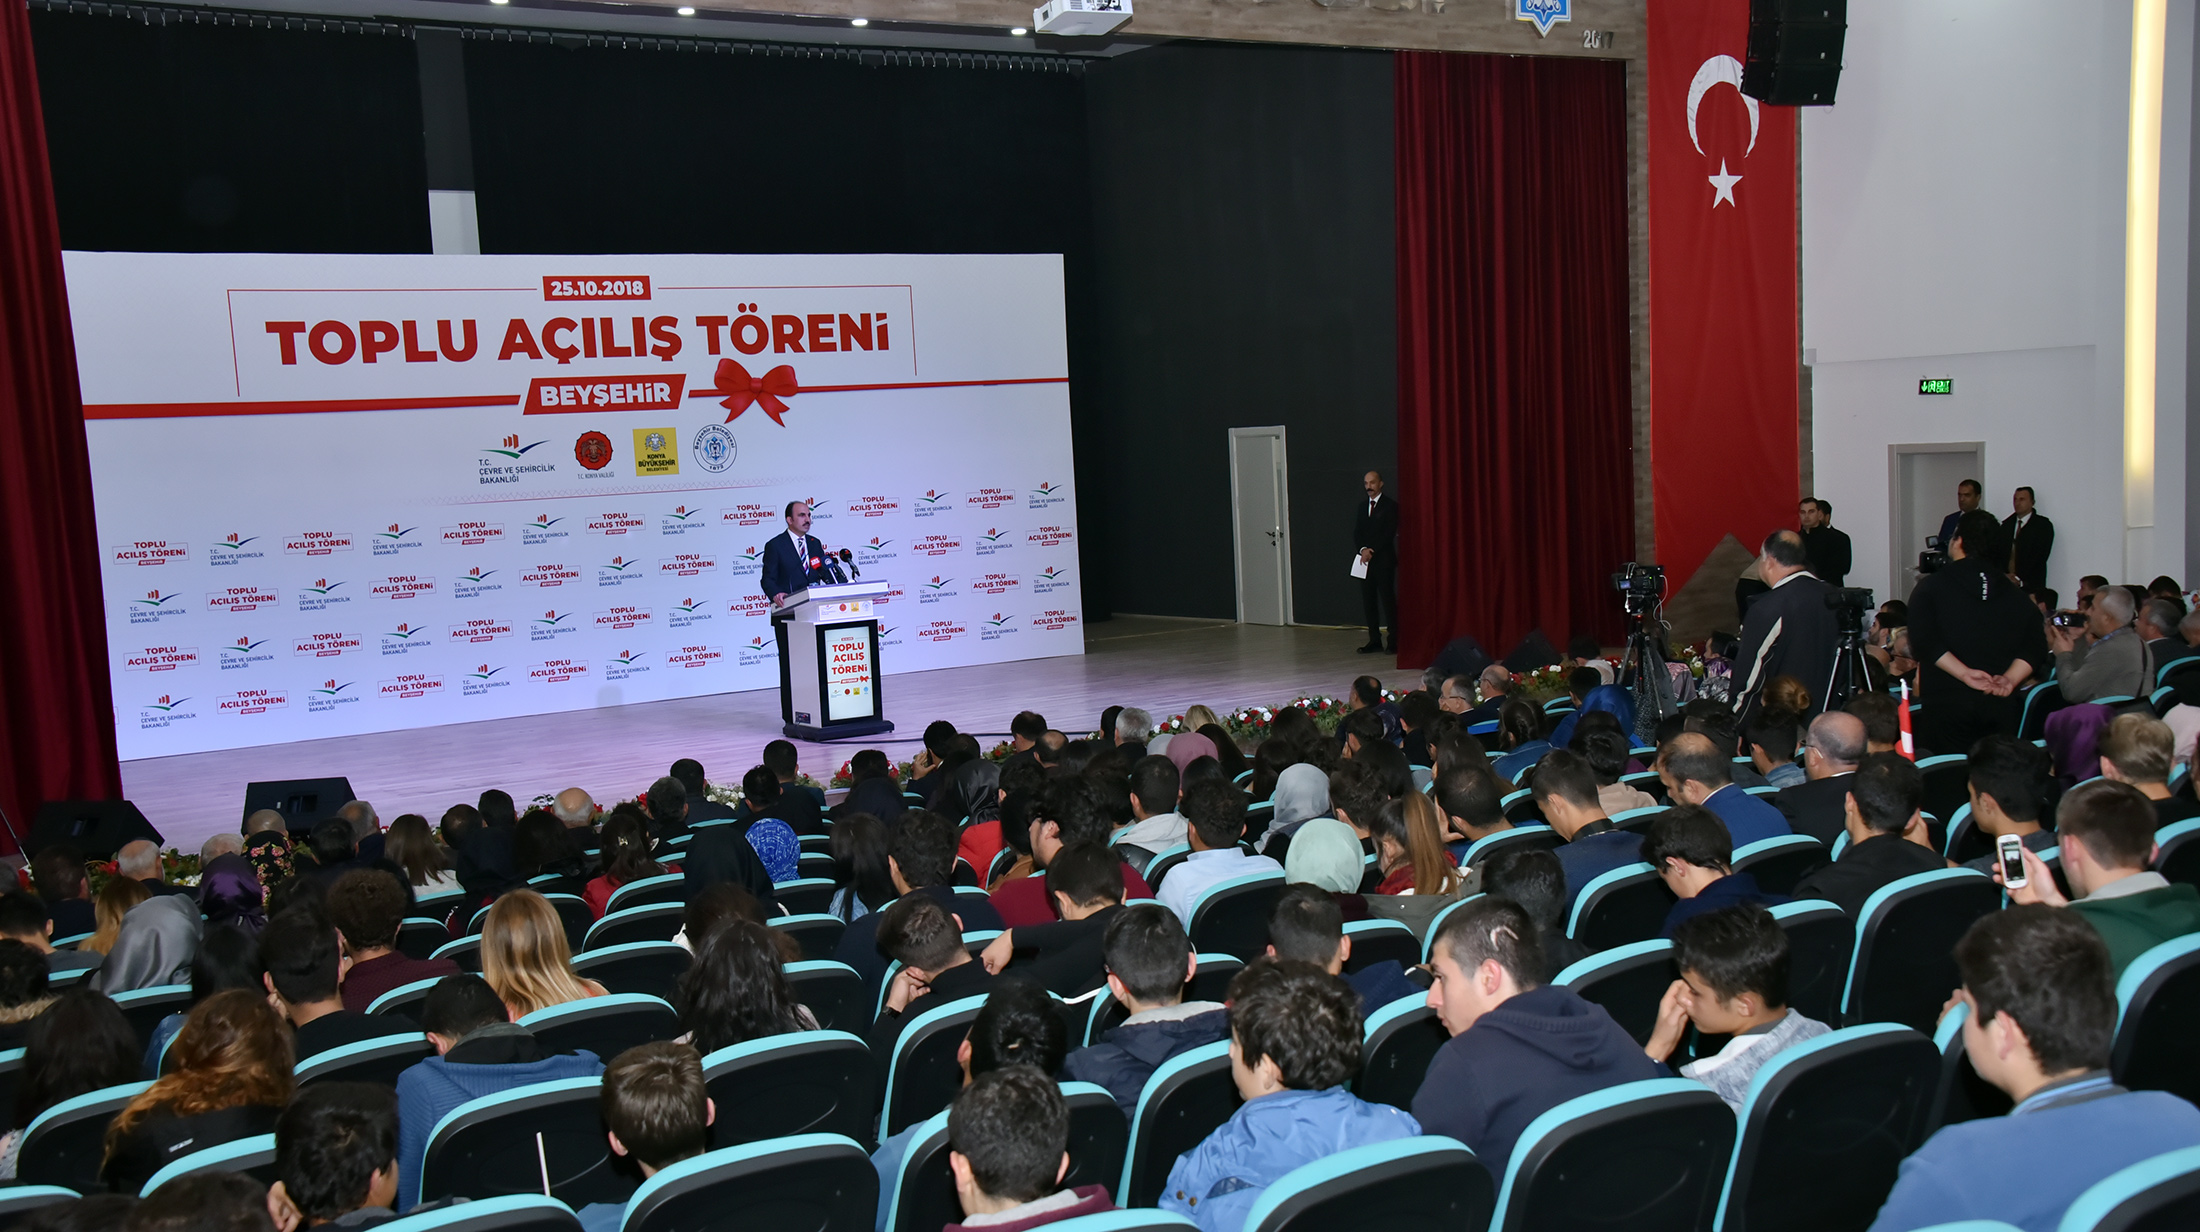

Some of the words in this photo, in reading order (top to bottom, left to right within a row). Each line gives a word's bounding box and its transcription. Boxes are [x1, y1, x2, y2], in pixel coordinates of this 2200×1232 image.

[550, 281, 645, 297] 25.10.2018
[265, 319, 478, 366] TOPLU
[497, 316, 683, 365] AÇILIŞ
[478, 459, 492, 467] T.C.
[479, 467, 503, 476] ÇEVRE
[504, 466, 514, 474] VE
[480, 475, 519, 484] BAKANLIĞI
[602, 512, 628, 520] TOPLU
[458, 521, 486, 529] TOPLU
[303, 531, 332, 539] TOPLU
[443, 531, 470, 539] AÇILIŞ
[134, 541, 166, 549] TOPLU
[286, 541, 316, 550] AÇILIŞ
[116, 551, 148, 560] AÇILIŞ
[388, 575, 416, 583] TOPLU
[226, 587, 257, 595] TOPLU
[372, 585, 400, 594] AÇILIŞ
[210, 597, 240, 606] AÇILIŞ
[743, 594, 766, 602] TOPLU
[609, 606, 635, 614] TOPLU
[467, 619, 494, 627] TOPLU
[312, 632, 342, 641] TOPLU
[451, 629, 479, 637] AÇILIŞ
[145, 646, 177, 655] TOPLU
[296, 643, 325, 652] AÇILIŞ
[682, 645, 706, 653] TOPLU
[832, 642, 864, 652] TOPLU
[127, 657, 159, 666] AÇILIŞ
[834, 652, 864, 662] AÇILIŞ
[544, 659, 571, 667] TOPLU
[396, 674, 425, 682] TOPLU
[381, 684, 409, 693] AÇILIŞ
[236, 689, 267, 698] TOPLU
[219, 700, 250, 709] AÇILIŞ
